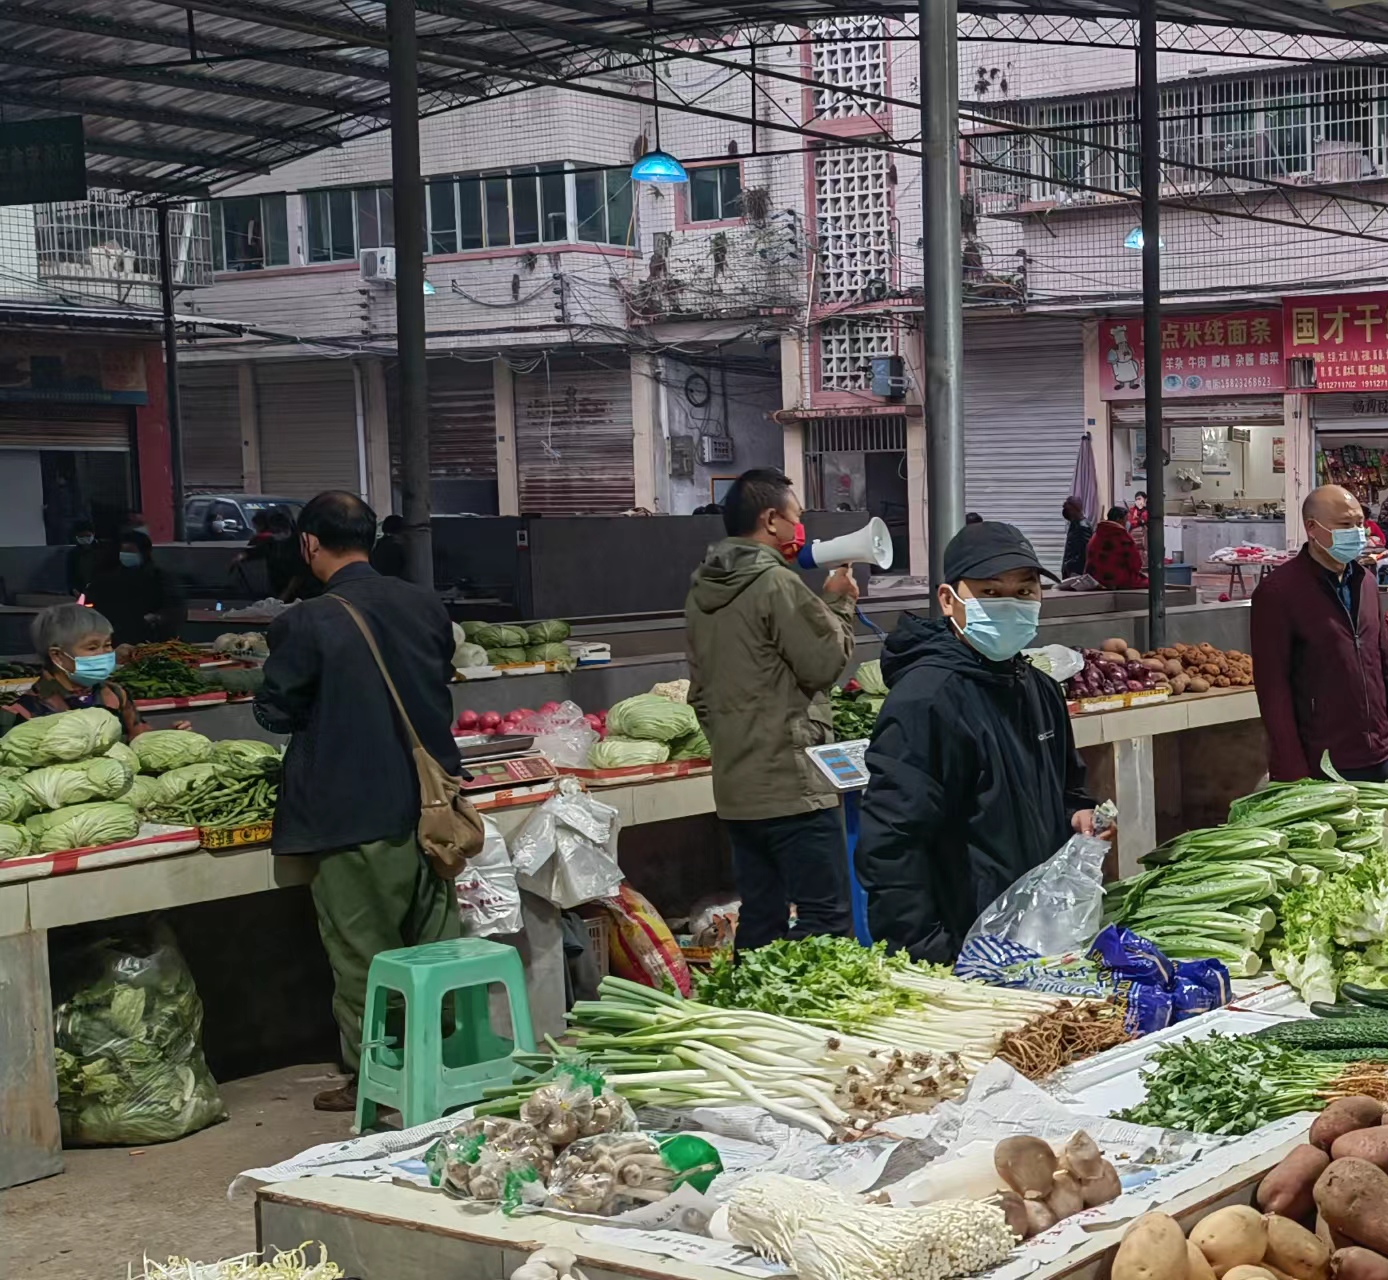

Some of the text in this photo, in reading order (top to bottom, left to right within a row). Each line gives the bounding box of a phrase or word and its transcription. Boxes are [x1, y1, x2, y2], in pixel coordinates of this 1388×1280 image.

[1141, 318, 1272, 348] 点米线面条
[1188, 356, 1207, 368] 牛肉
